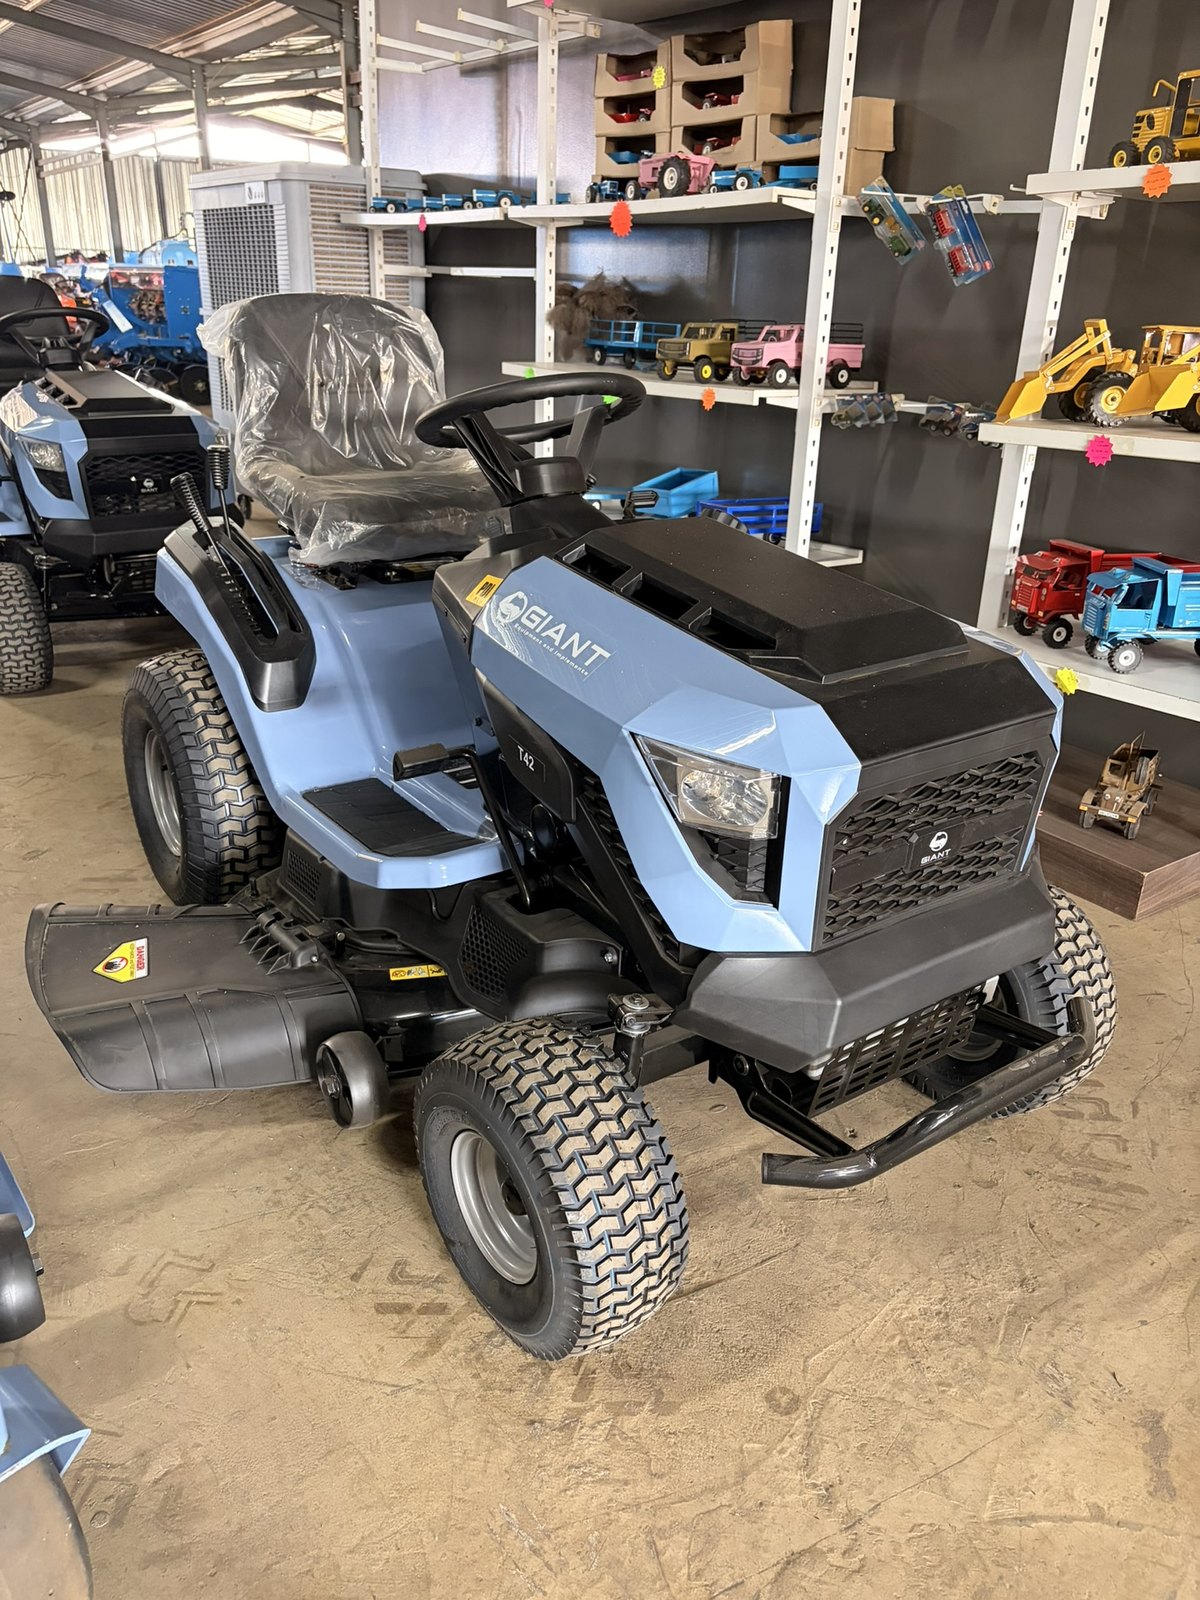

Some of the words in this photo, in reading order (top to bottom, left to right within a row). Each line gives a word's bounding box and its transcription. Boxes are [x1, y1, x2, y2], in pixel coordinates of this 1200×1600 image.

[514, 623, 542, 645] Equipment
[542, 643, 554, 652] and
[520, 605, 611, 667] GIANT
[517, 744, 535, 772] T42
[920, 848, 952, 864] GIANT
[136, 945, 145, 971] DANGER
